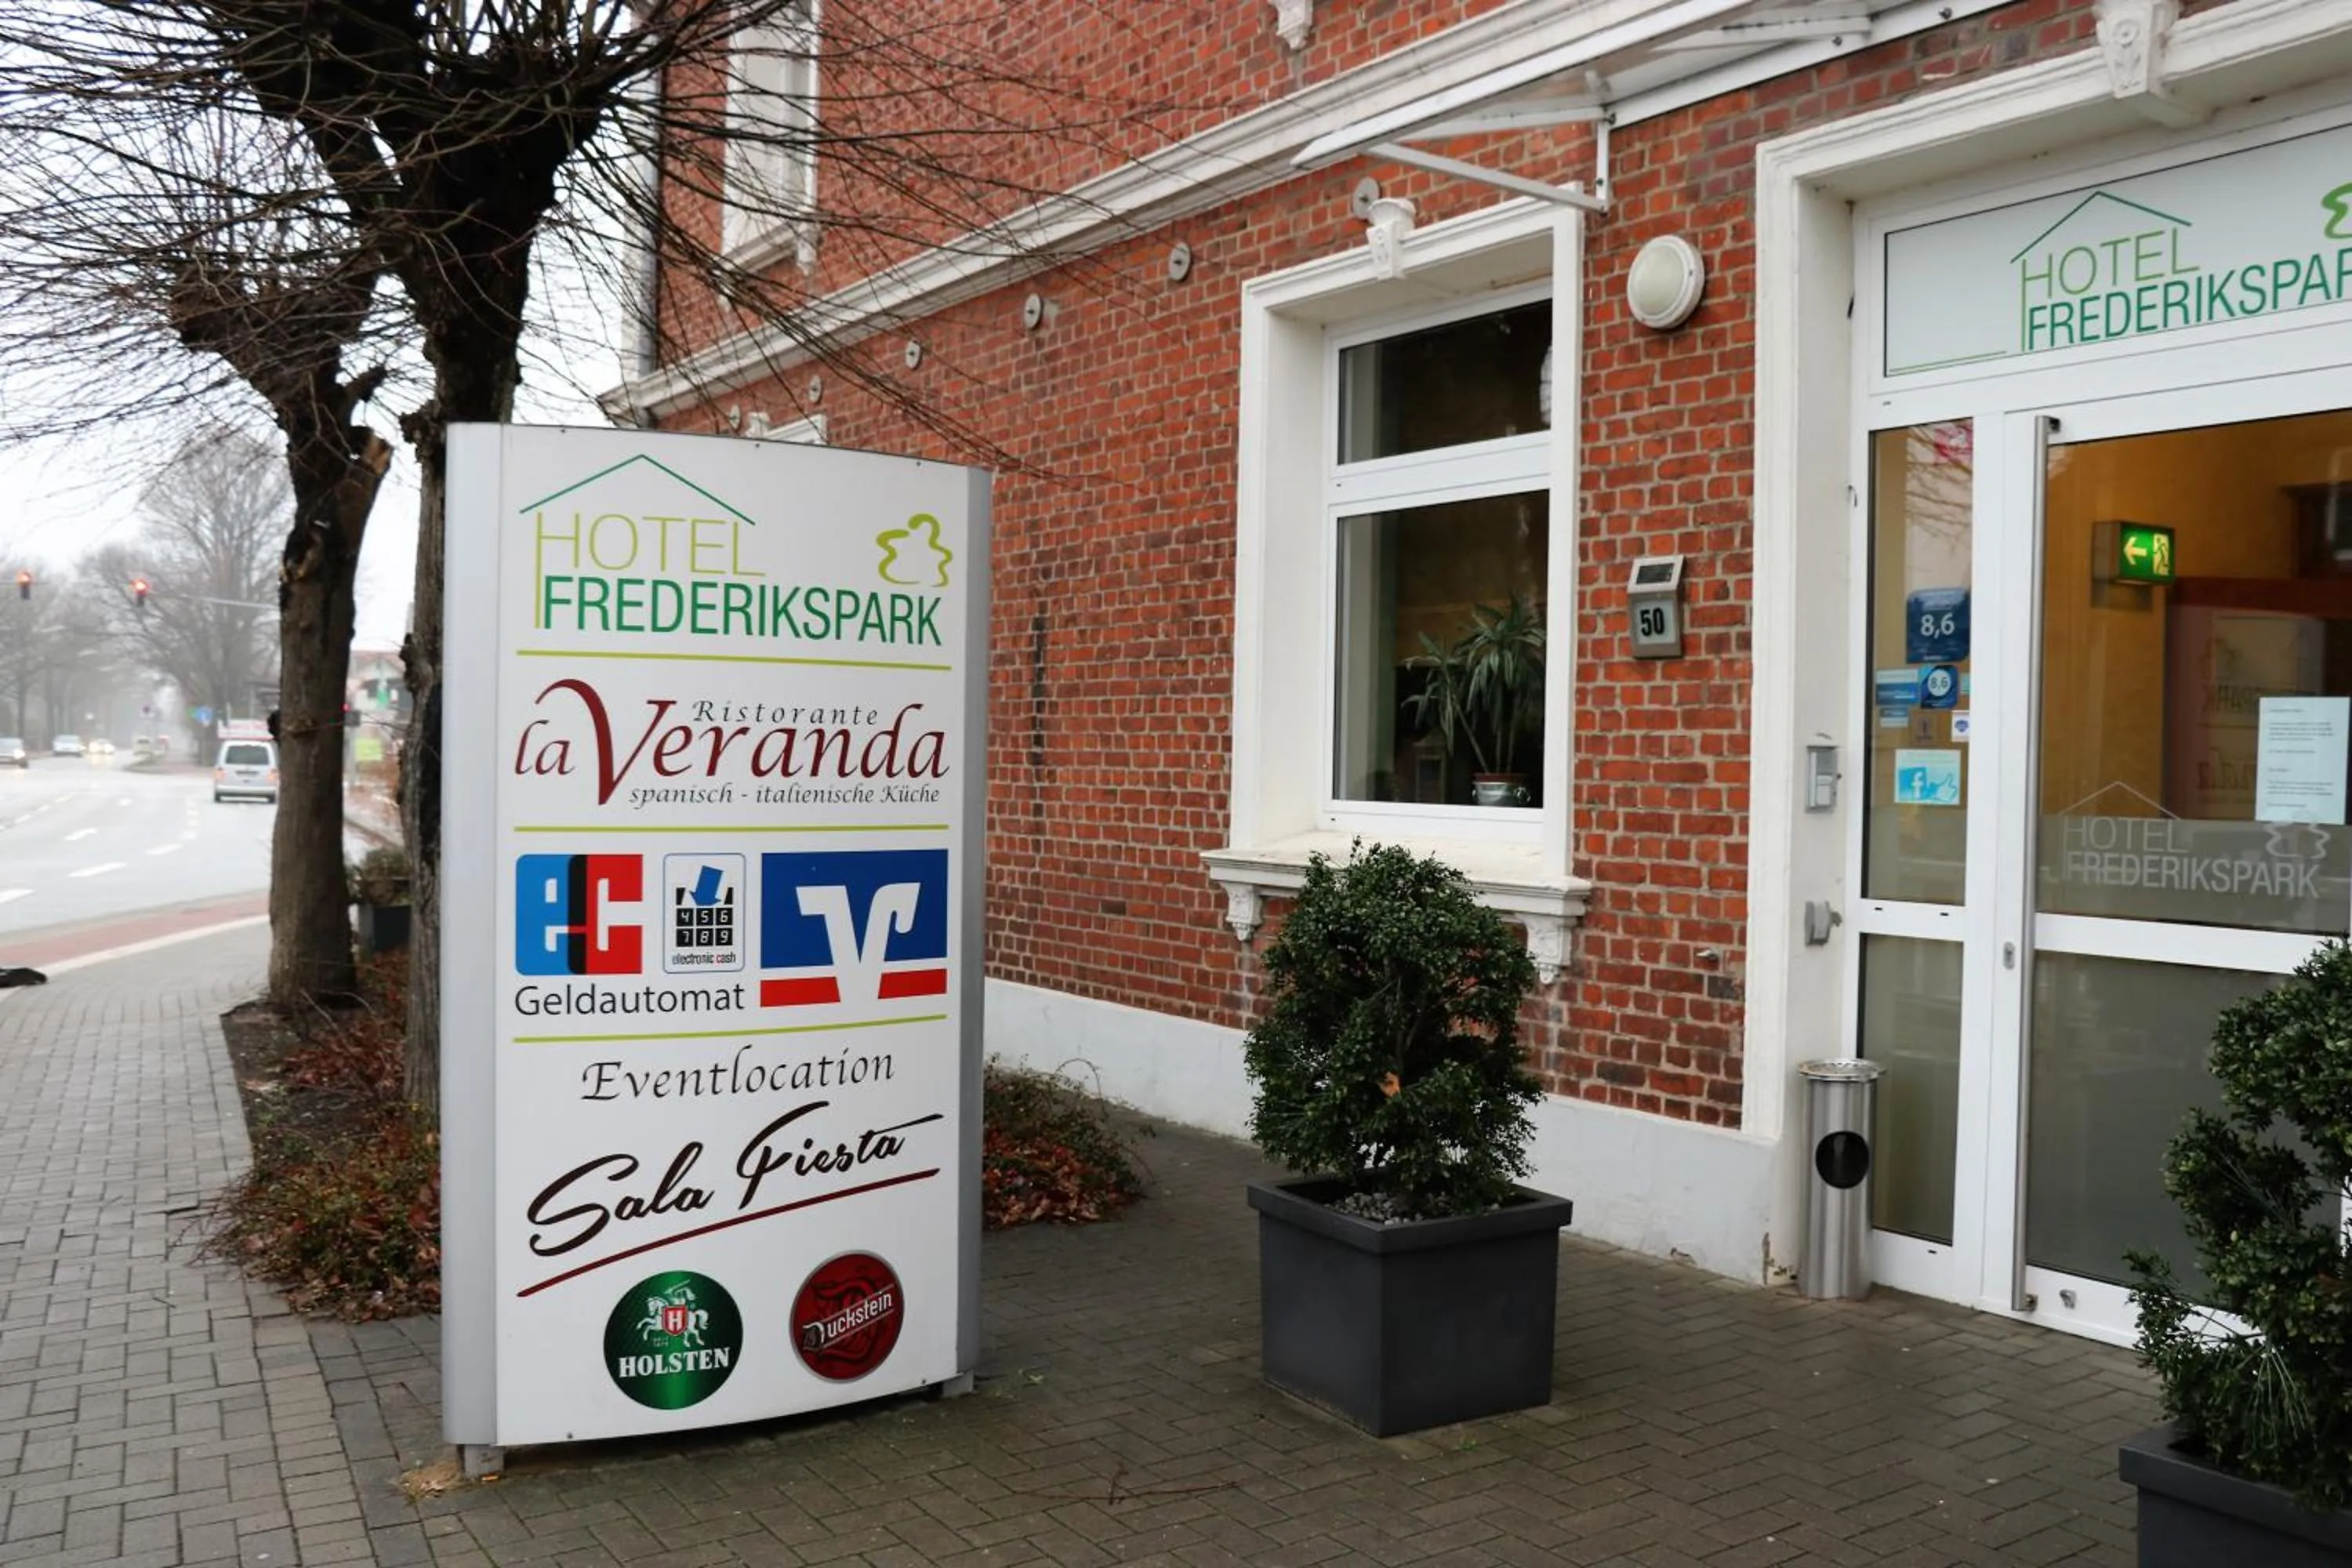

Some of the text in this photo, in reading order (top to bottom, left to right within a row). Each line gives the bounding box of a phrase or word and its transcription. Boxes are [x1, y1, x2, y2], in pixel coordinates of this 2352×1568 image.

[2020, 227, 2201, 299] HOTEL
[2027, 247, 2352, 351] FREDERIKSPA
[535, 511, 765, 577] HOTEL
[544, 575, 942, 646] FREDERIKSPARK
[1639, 607, 1665, 637] 50
[1920, 612, 1955, 639] 8,6
[692, 699, 879, 726] Ristorante
[514, 677, 950, 806] la Veranda
[629, 782, 732, 810] spanisch
[756, 782, 875, 804] italienische
[878, 782, 940, 804] Küche
[2063, 815, 2192, 855] HOTEL
[2066, 850, 2321, 899] FREDERIKSPARK
[672, 950, 736, 965] electronic cash
[514, 982, 745, 1016] Geldautomat
[581, 1044, 895, 1101] Eventlocation
[526, 1100, 944, 1257] Sala Fiesta
[802, 1291, 893, 1352] Duckstein
[618, 1346, 731, 1378] HOLSTEN
